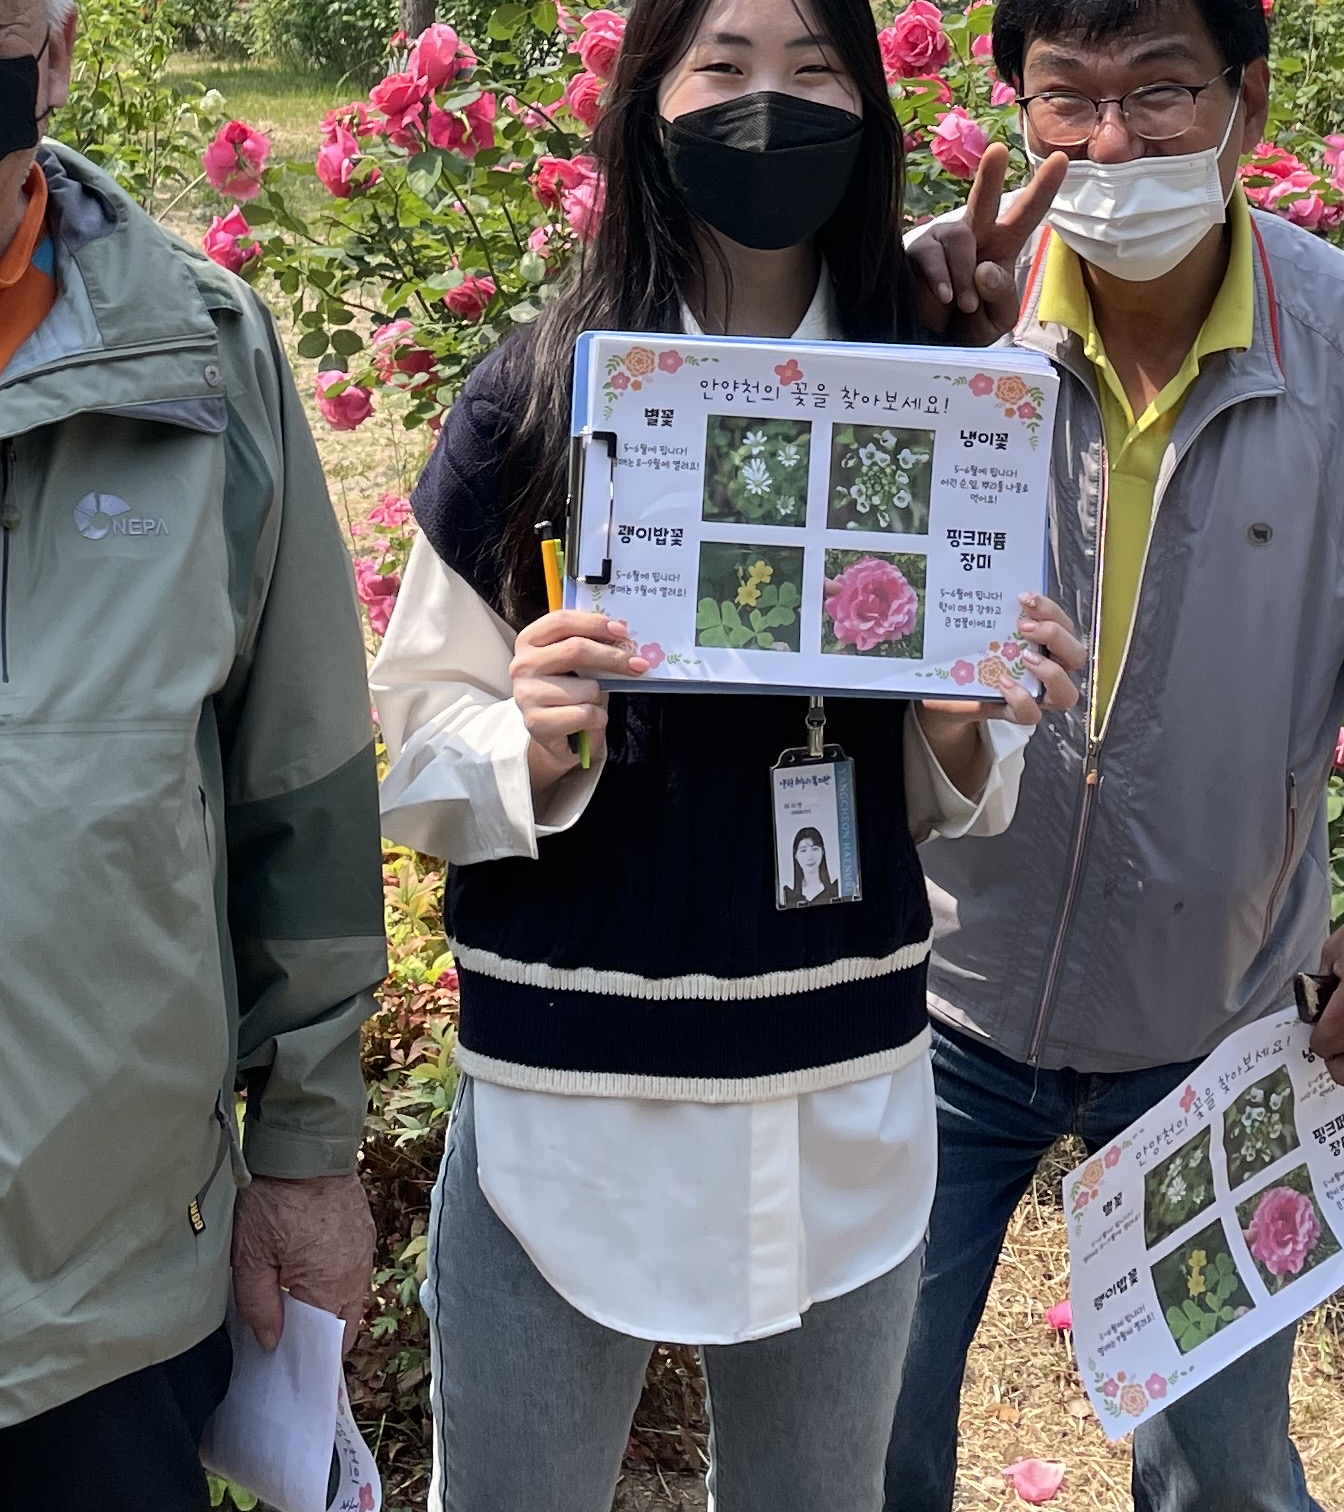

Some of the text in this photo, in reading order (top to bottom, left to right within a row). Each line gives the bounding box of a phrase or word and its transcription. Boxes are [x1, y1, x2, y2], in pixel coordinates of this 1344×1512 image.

[700, 378, 950, 415] 안양천의 꽃을 찾아보세요!
[644, 408, 675, 427] 별꽃
[960, 430, 1009, 450] 냉이꽃
[112, 518, 170, 536] NEPA
[617, 525, 684, 546] 괭이밥꽃
[946, 529, 1006, 550] 핑크퍼퓸
[960, 553, 991, 571] 장미
[1135, 1116, 1189, 1167] 안양천의
[1193, 1088, 1216, 1121] 꽃을
[1218, 1035, 1291, 1095] 찾아보세요!
